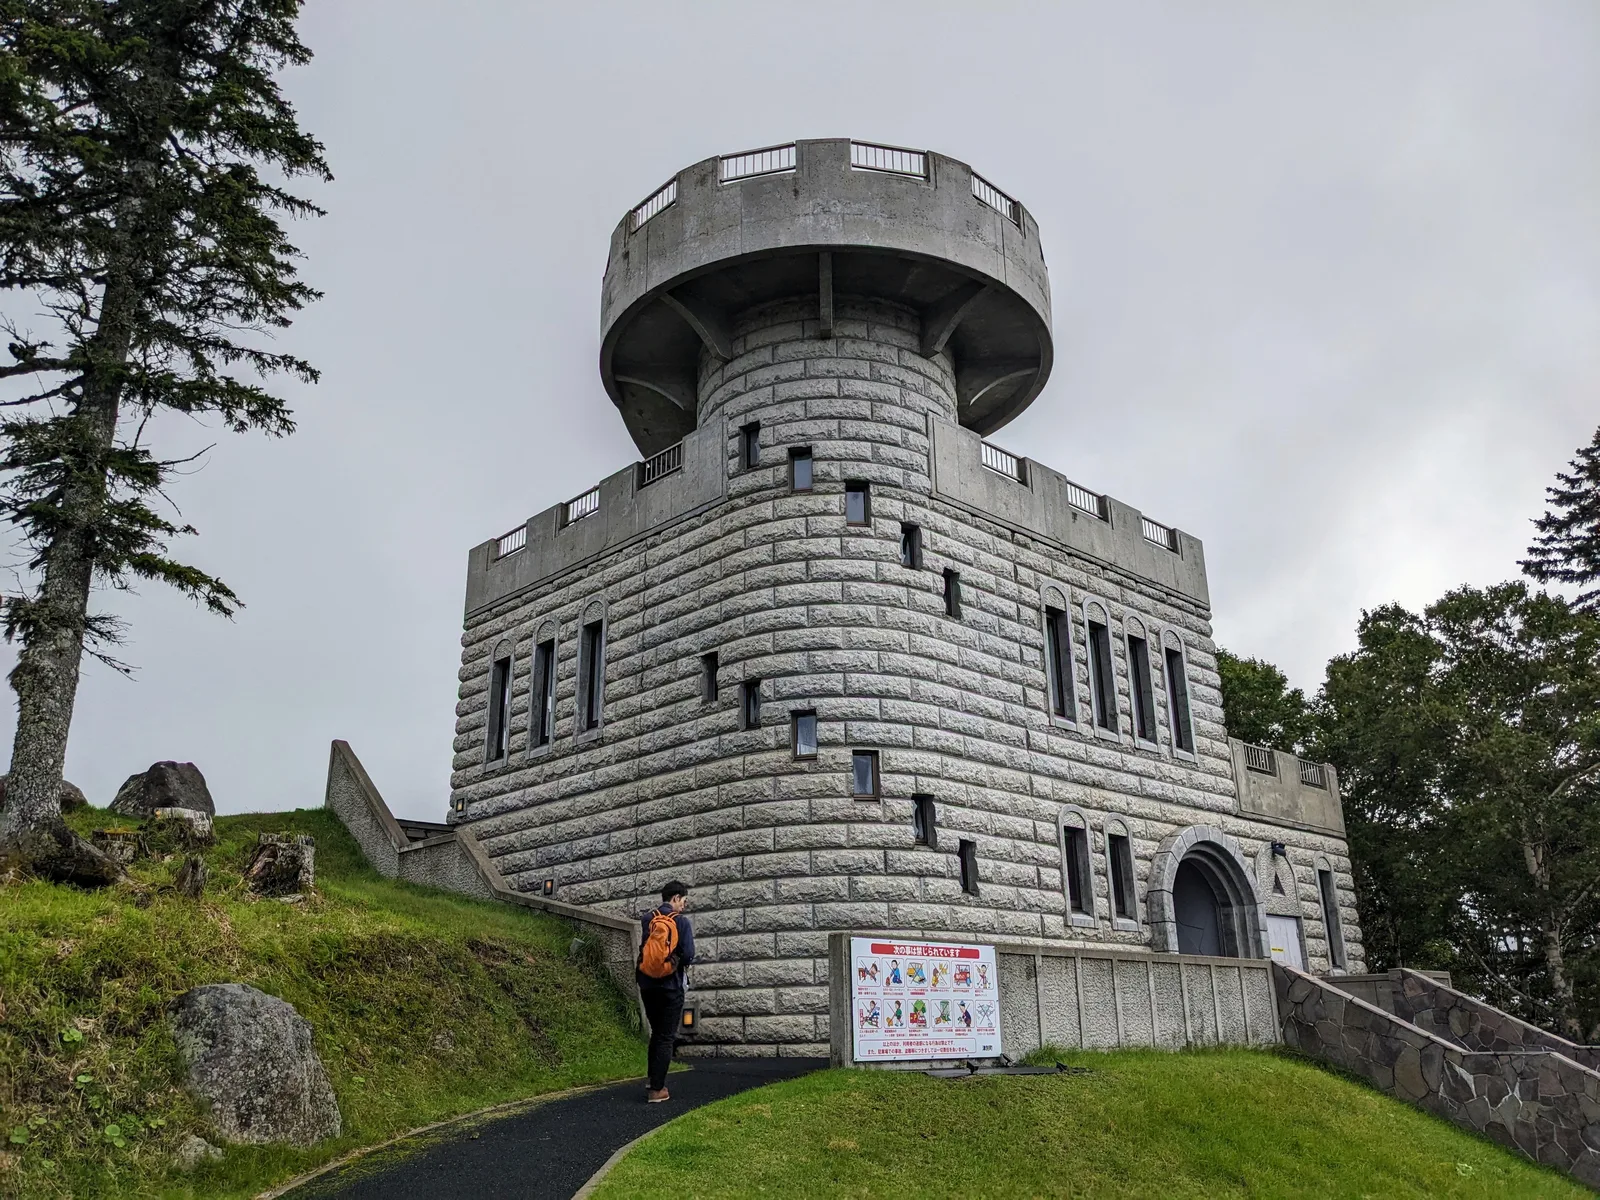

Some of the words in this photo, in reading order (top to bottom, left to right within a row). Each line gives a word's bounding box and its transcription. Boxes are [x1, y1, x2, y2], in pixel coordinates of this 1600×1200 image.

[893, 946, 961, 957] 次の事は禁じられています
